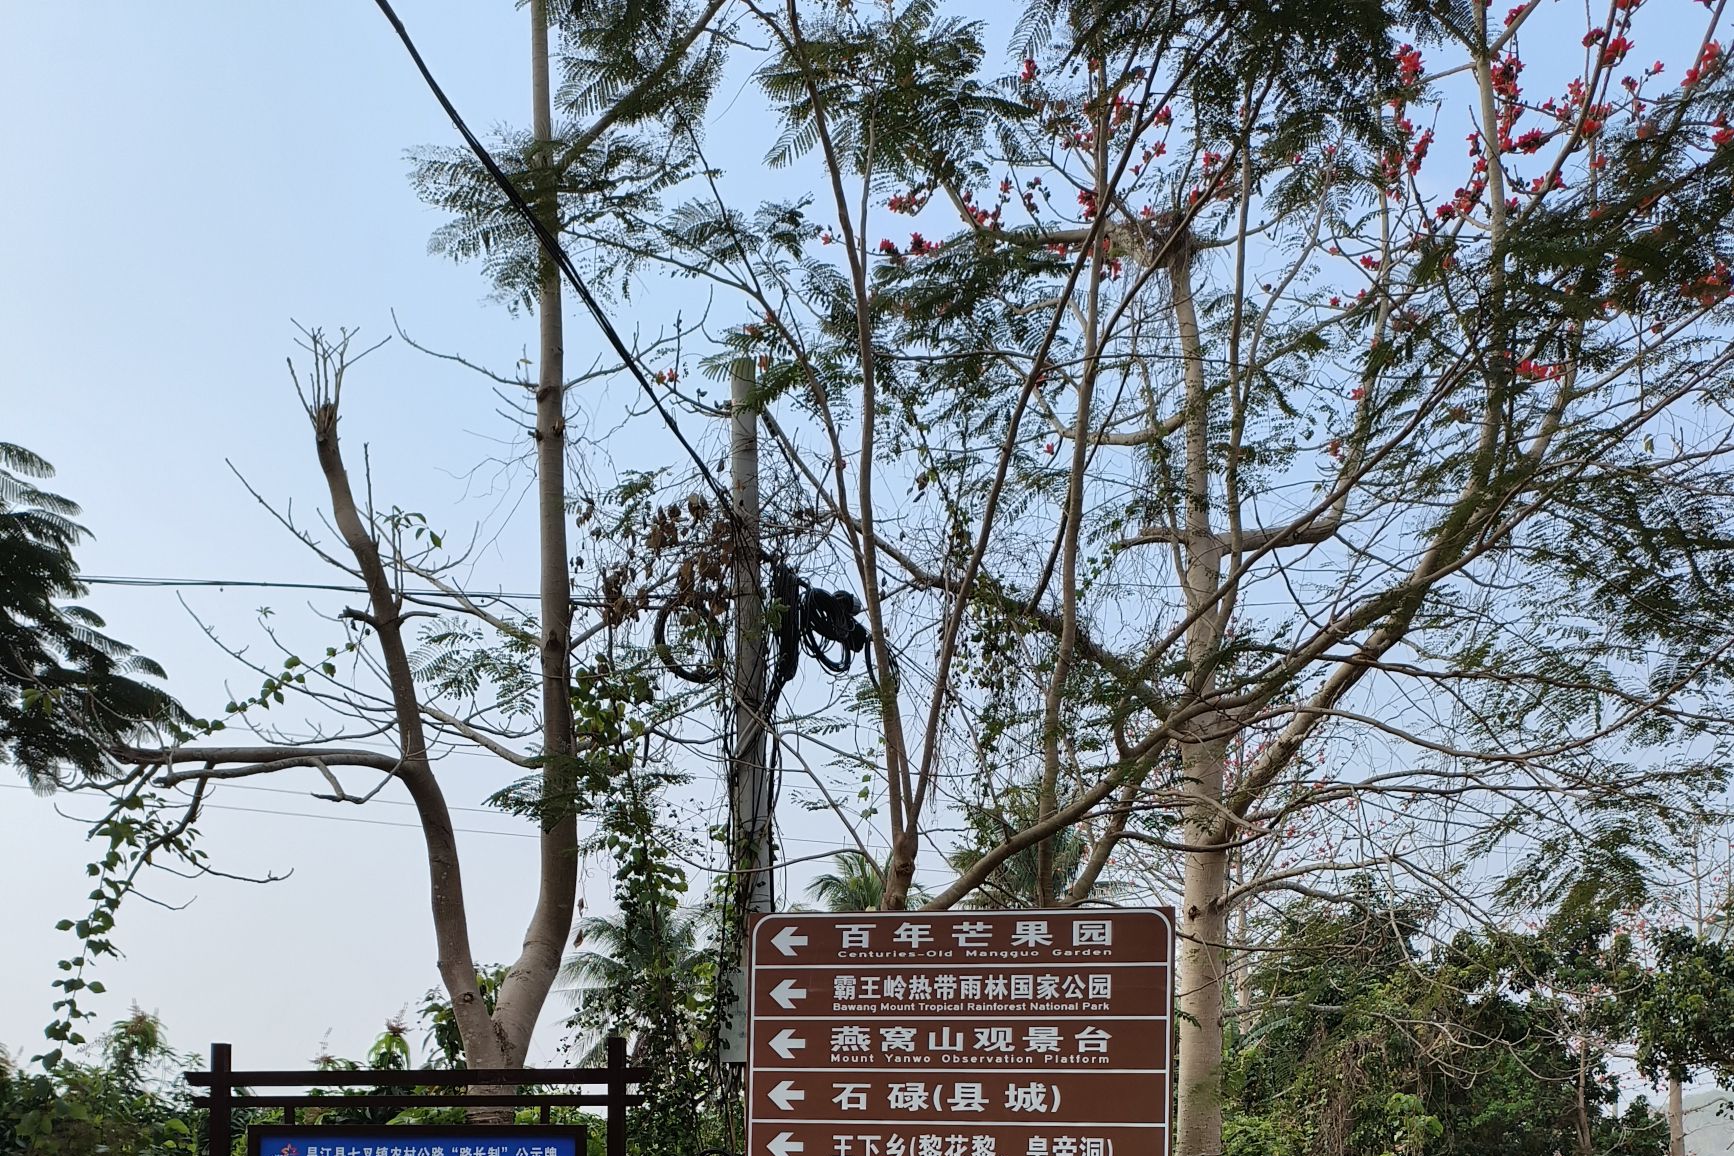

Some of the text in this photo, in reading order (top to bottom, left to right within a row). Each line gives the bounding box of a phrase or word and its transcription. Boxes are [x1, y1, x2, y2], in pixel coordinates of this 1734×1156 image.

[835, 921, 1112, 950] 百年芒果园
[966, 950, 1038, 958] Mangguo
[834, 974, 1111, 1000] 霸王岭热带雨林国家公园
[833, 1003, 876, 1012] Bawang
[919, 1003, 963, 1012] Tropical
[830, 1026, 1112, 1052] 燕窝山观景台
[831, 1054, 1109, 1063] Mount Yanwo Observation Platform
